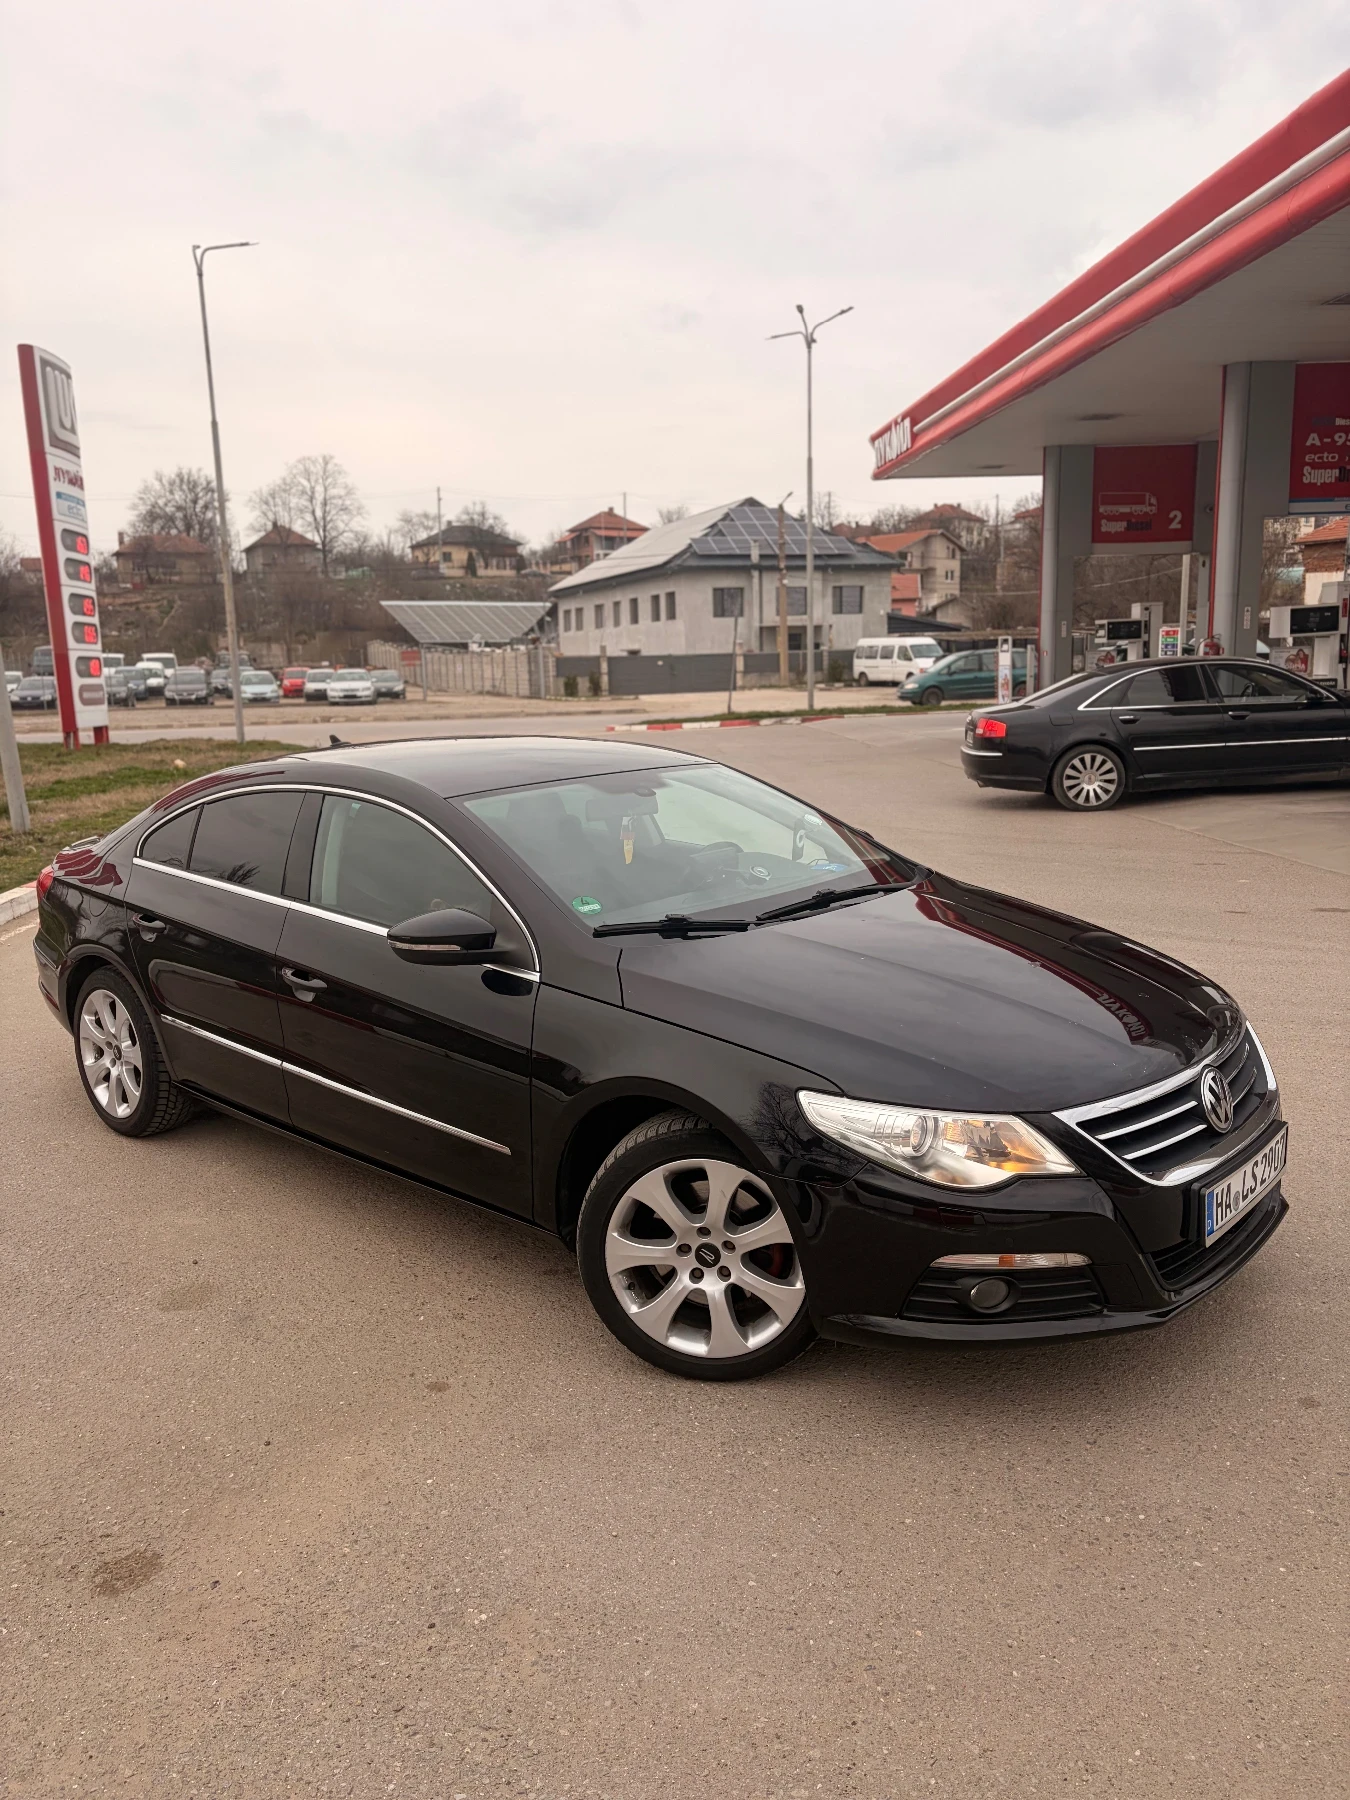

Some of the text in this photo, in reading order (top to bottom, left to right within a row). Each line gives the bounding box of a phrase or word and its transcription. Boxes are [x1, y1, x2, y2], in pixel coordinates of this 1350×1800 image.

[1305, 451, 1338, 463] ecto
[1168, 510, 1183, 529] 2
[1216, 1182, 1233, 1227] HA
[1241, 1159, 1259, 1203] LS
